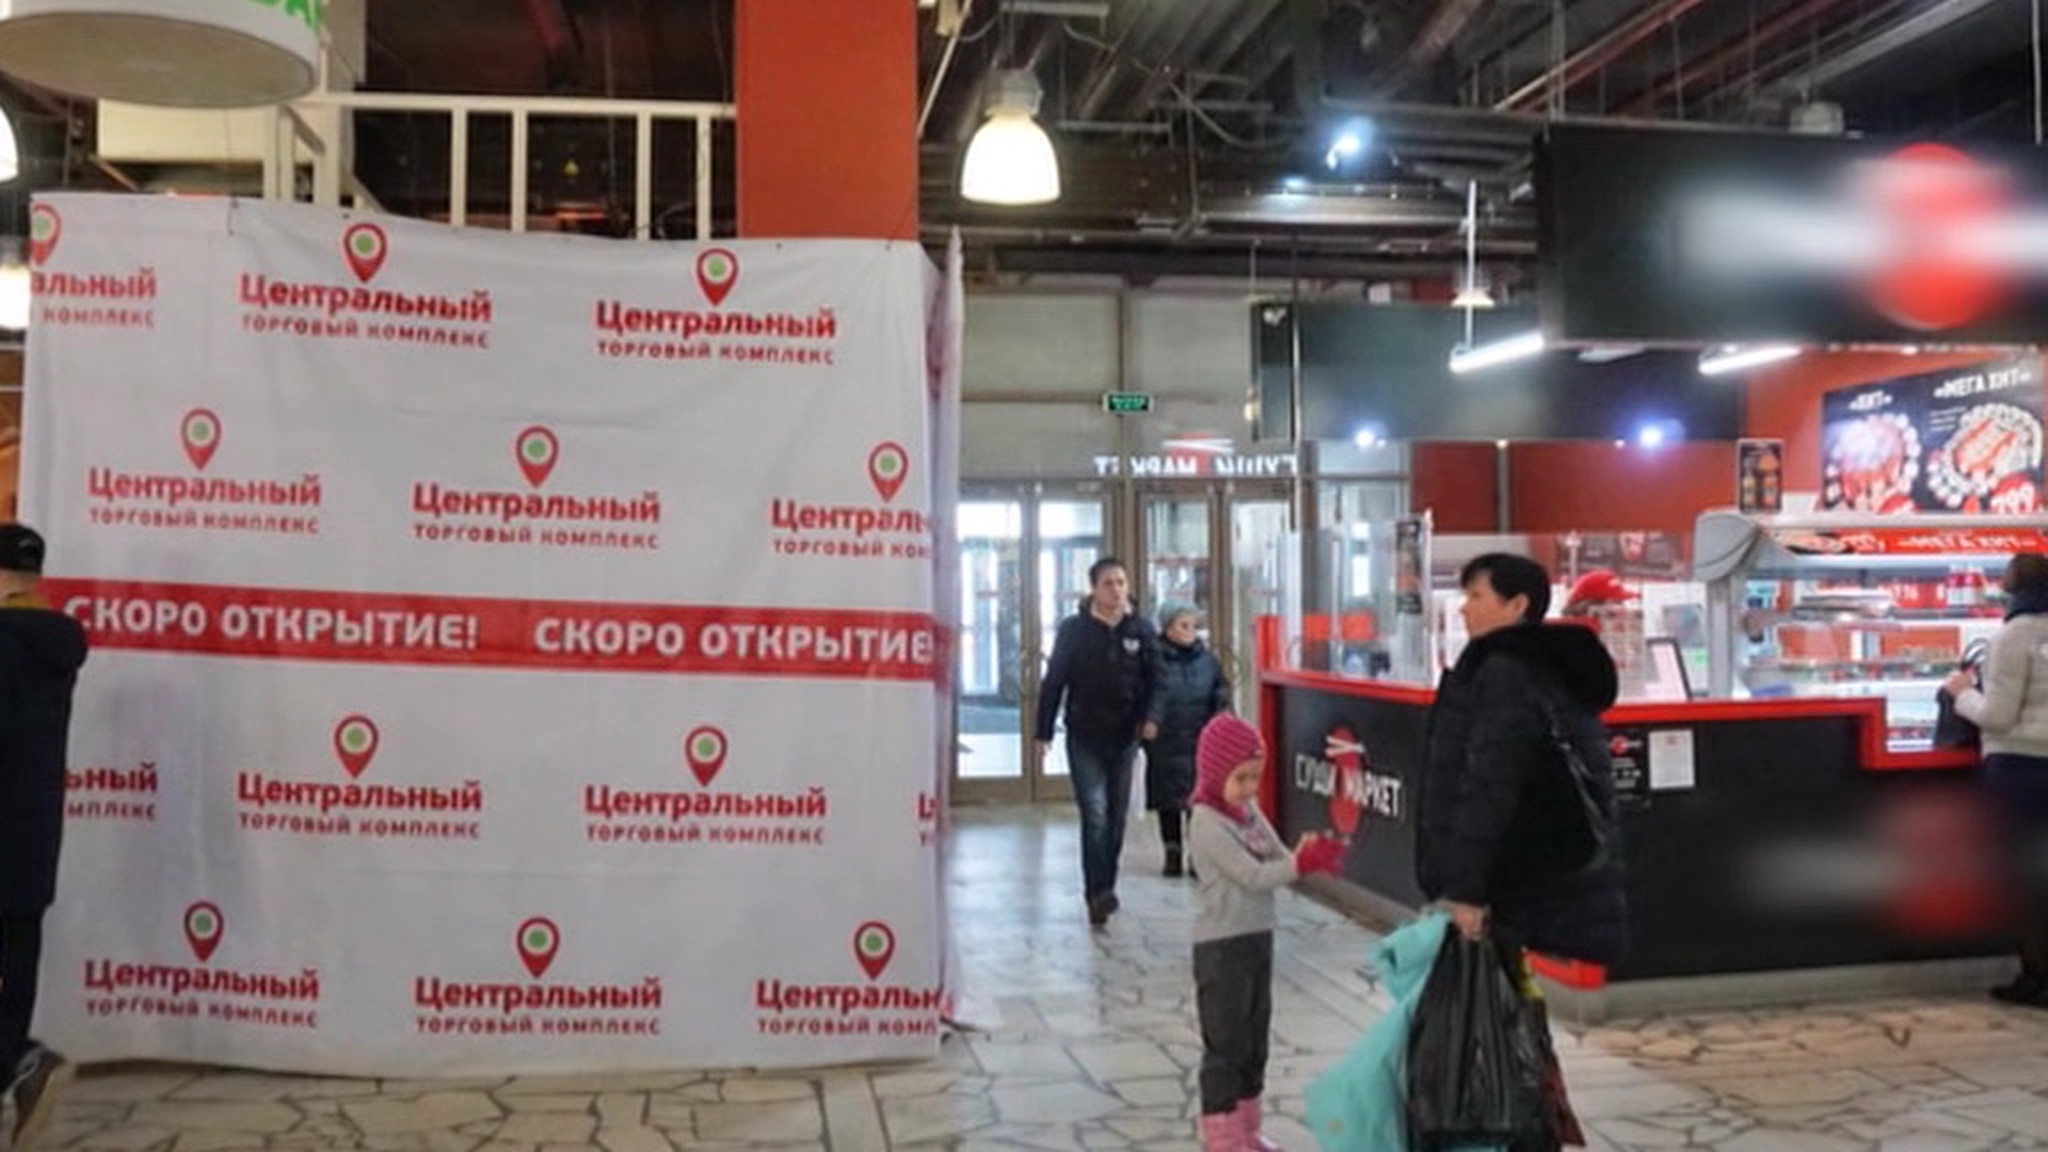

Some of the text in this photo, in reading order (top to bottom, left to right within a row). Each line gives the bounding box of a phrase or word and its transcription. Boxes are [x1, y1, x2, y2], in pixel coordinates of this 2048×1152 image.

[240, 272, 493, 322] Центральный
[44, 307, 155, 328] КОМПЛЕКС
[242, 313, 490, 350] ТОРГОВЫЙ КОМПЛЕКС
[596, 300, 837, 340] Центральный
[598, 341, 835, 365] ТОРГОВЫЙ КОМПЛЕКС
[87, 467, 322, 506] Центральный
[413, 482, 661, 522] Центральный
[90, 507, 319, 534] ТОРГОВЫЙ КОМПЛЕКС
[414, 523, 659, 550] ТОРГОВЫЙ КОМПЛЕКС
[774, 540, 884, 559] ТОРГОВЫЙ
[64, 596, 478, 650] СКОРО ОТКРЫТИЕ!
[534, 617, 685, 657] СКОРО
[237, 771, 482, 812] Центральный
[584, 785, 827, 821] Центральный
[240, 813, 480, 840] ТОРГОВЫЙ КОМПЛЕКС
[587, 824, 826, 846] ТОРГОВЫЙ КОМПЛЕКС
[84, 959, 320, 1001] Центральный
[414, 976, 662, 1012] Центральный
[86, 997, 319, 1029] ТОРГОВЫЙ КОМПЛЕКС
[416, 1017, 661, 1036] ТОРГОВЫЙ КОМПЛЕКС
[758, 1018, 871, 1036] ТОРГОВЫЙ
